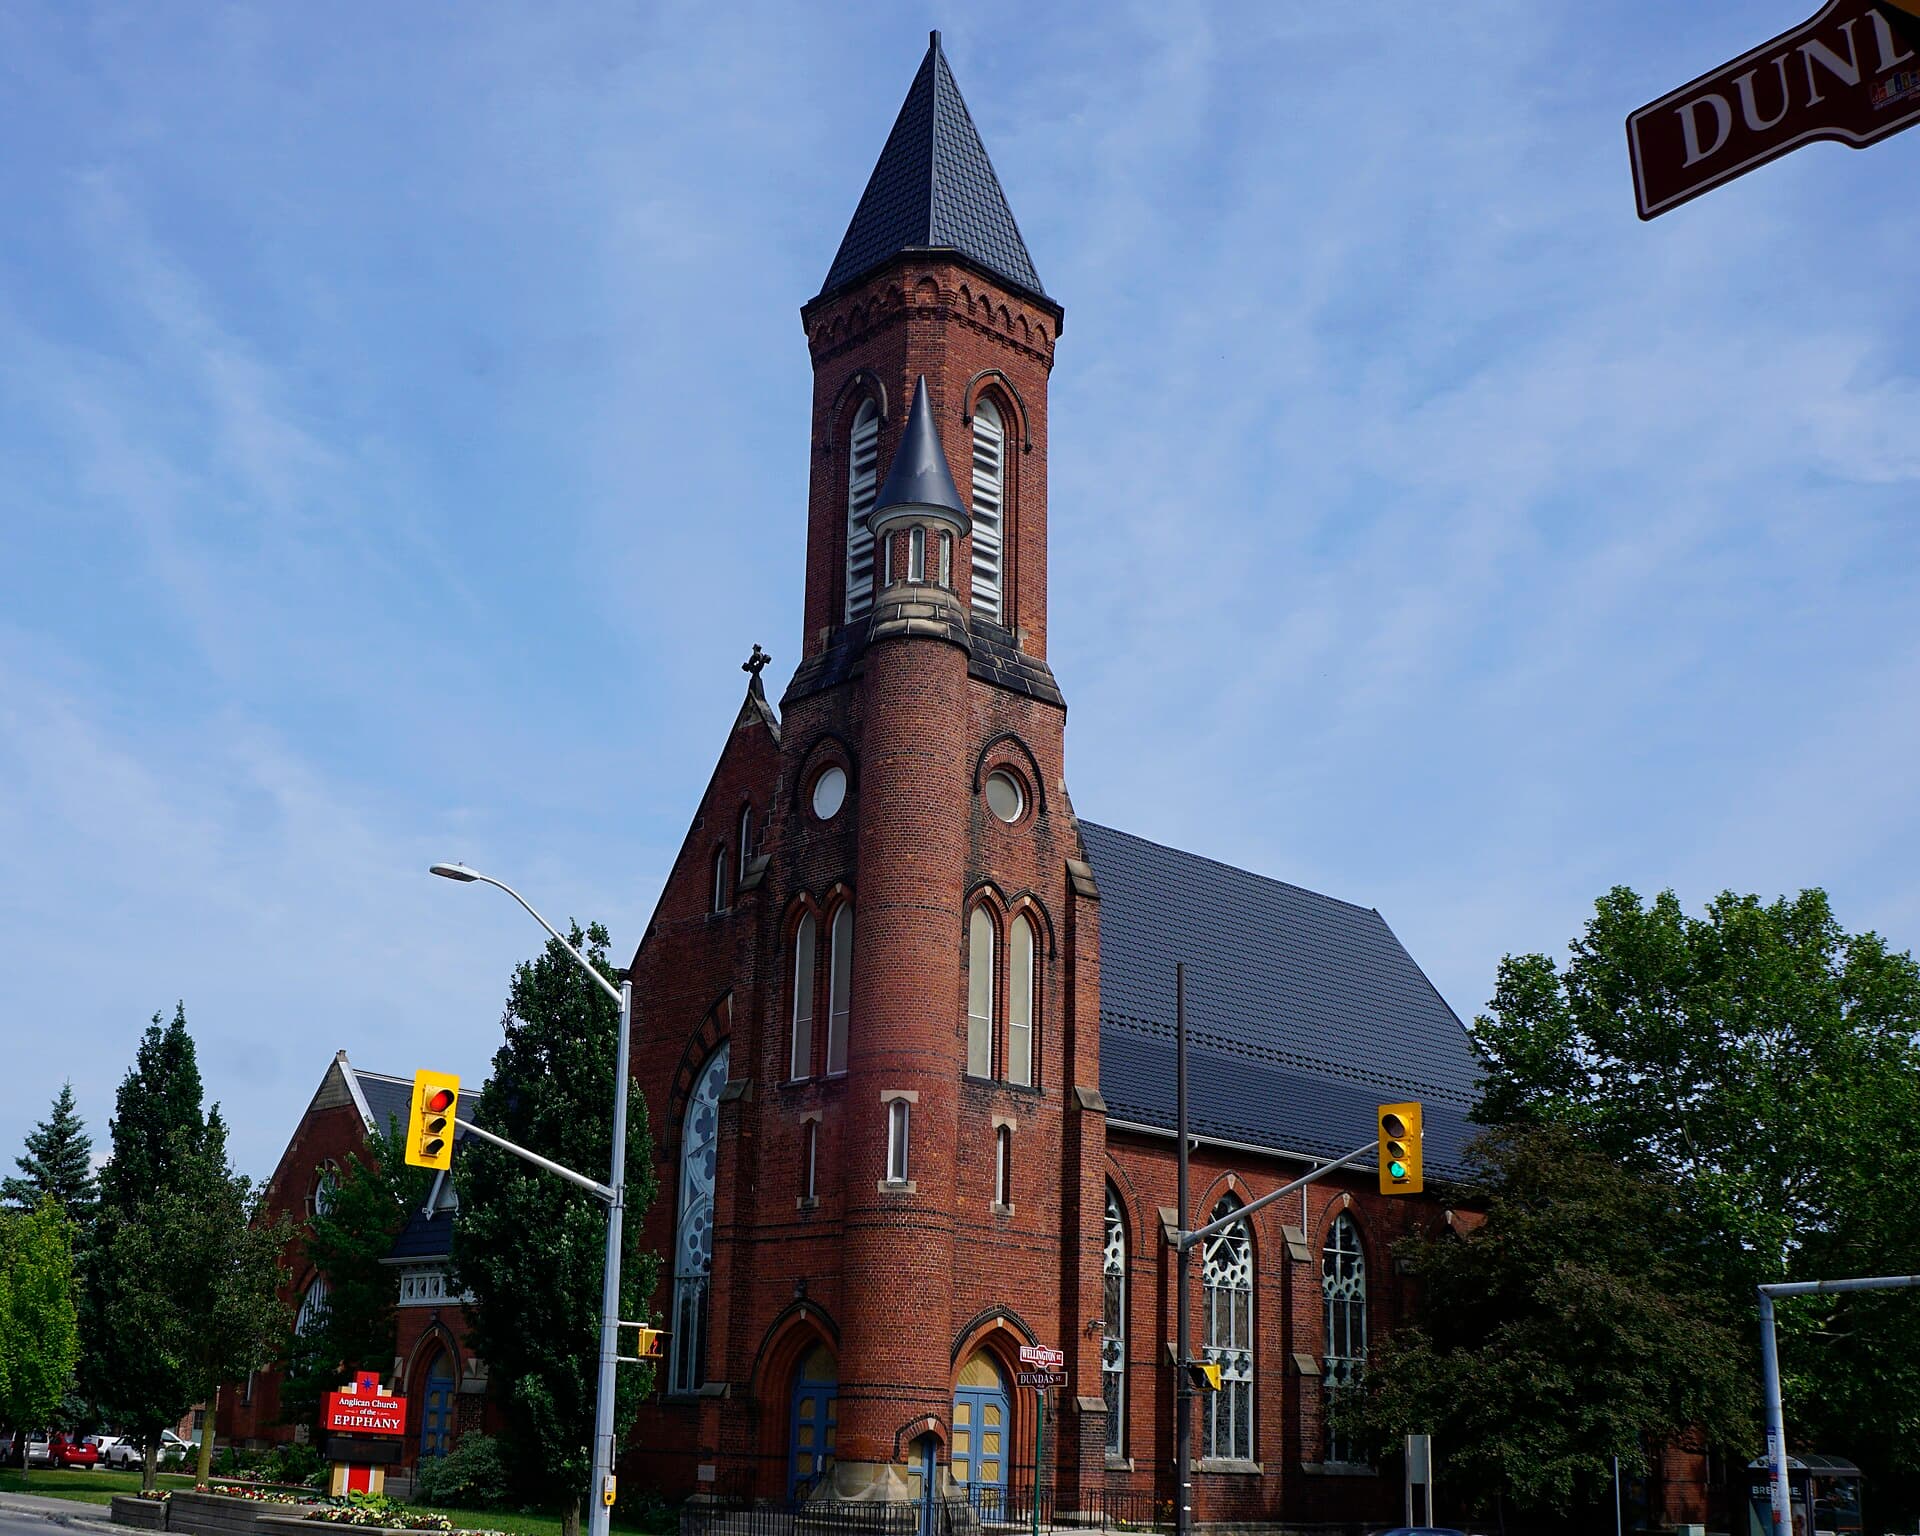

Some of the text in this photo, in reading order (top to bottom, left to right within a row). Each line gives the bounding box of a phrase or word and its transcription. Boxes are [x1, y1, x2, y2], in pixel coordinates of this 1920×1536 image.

[1022, 1349, 1056, 1362] WELLINGTON
[1020, 1374, 1054, 1384] DUNDAS
[339, 1397, 398, 1409] Anglican Church
[334, 1414, 400, 1429] EPIPHANY
